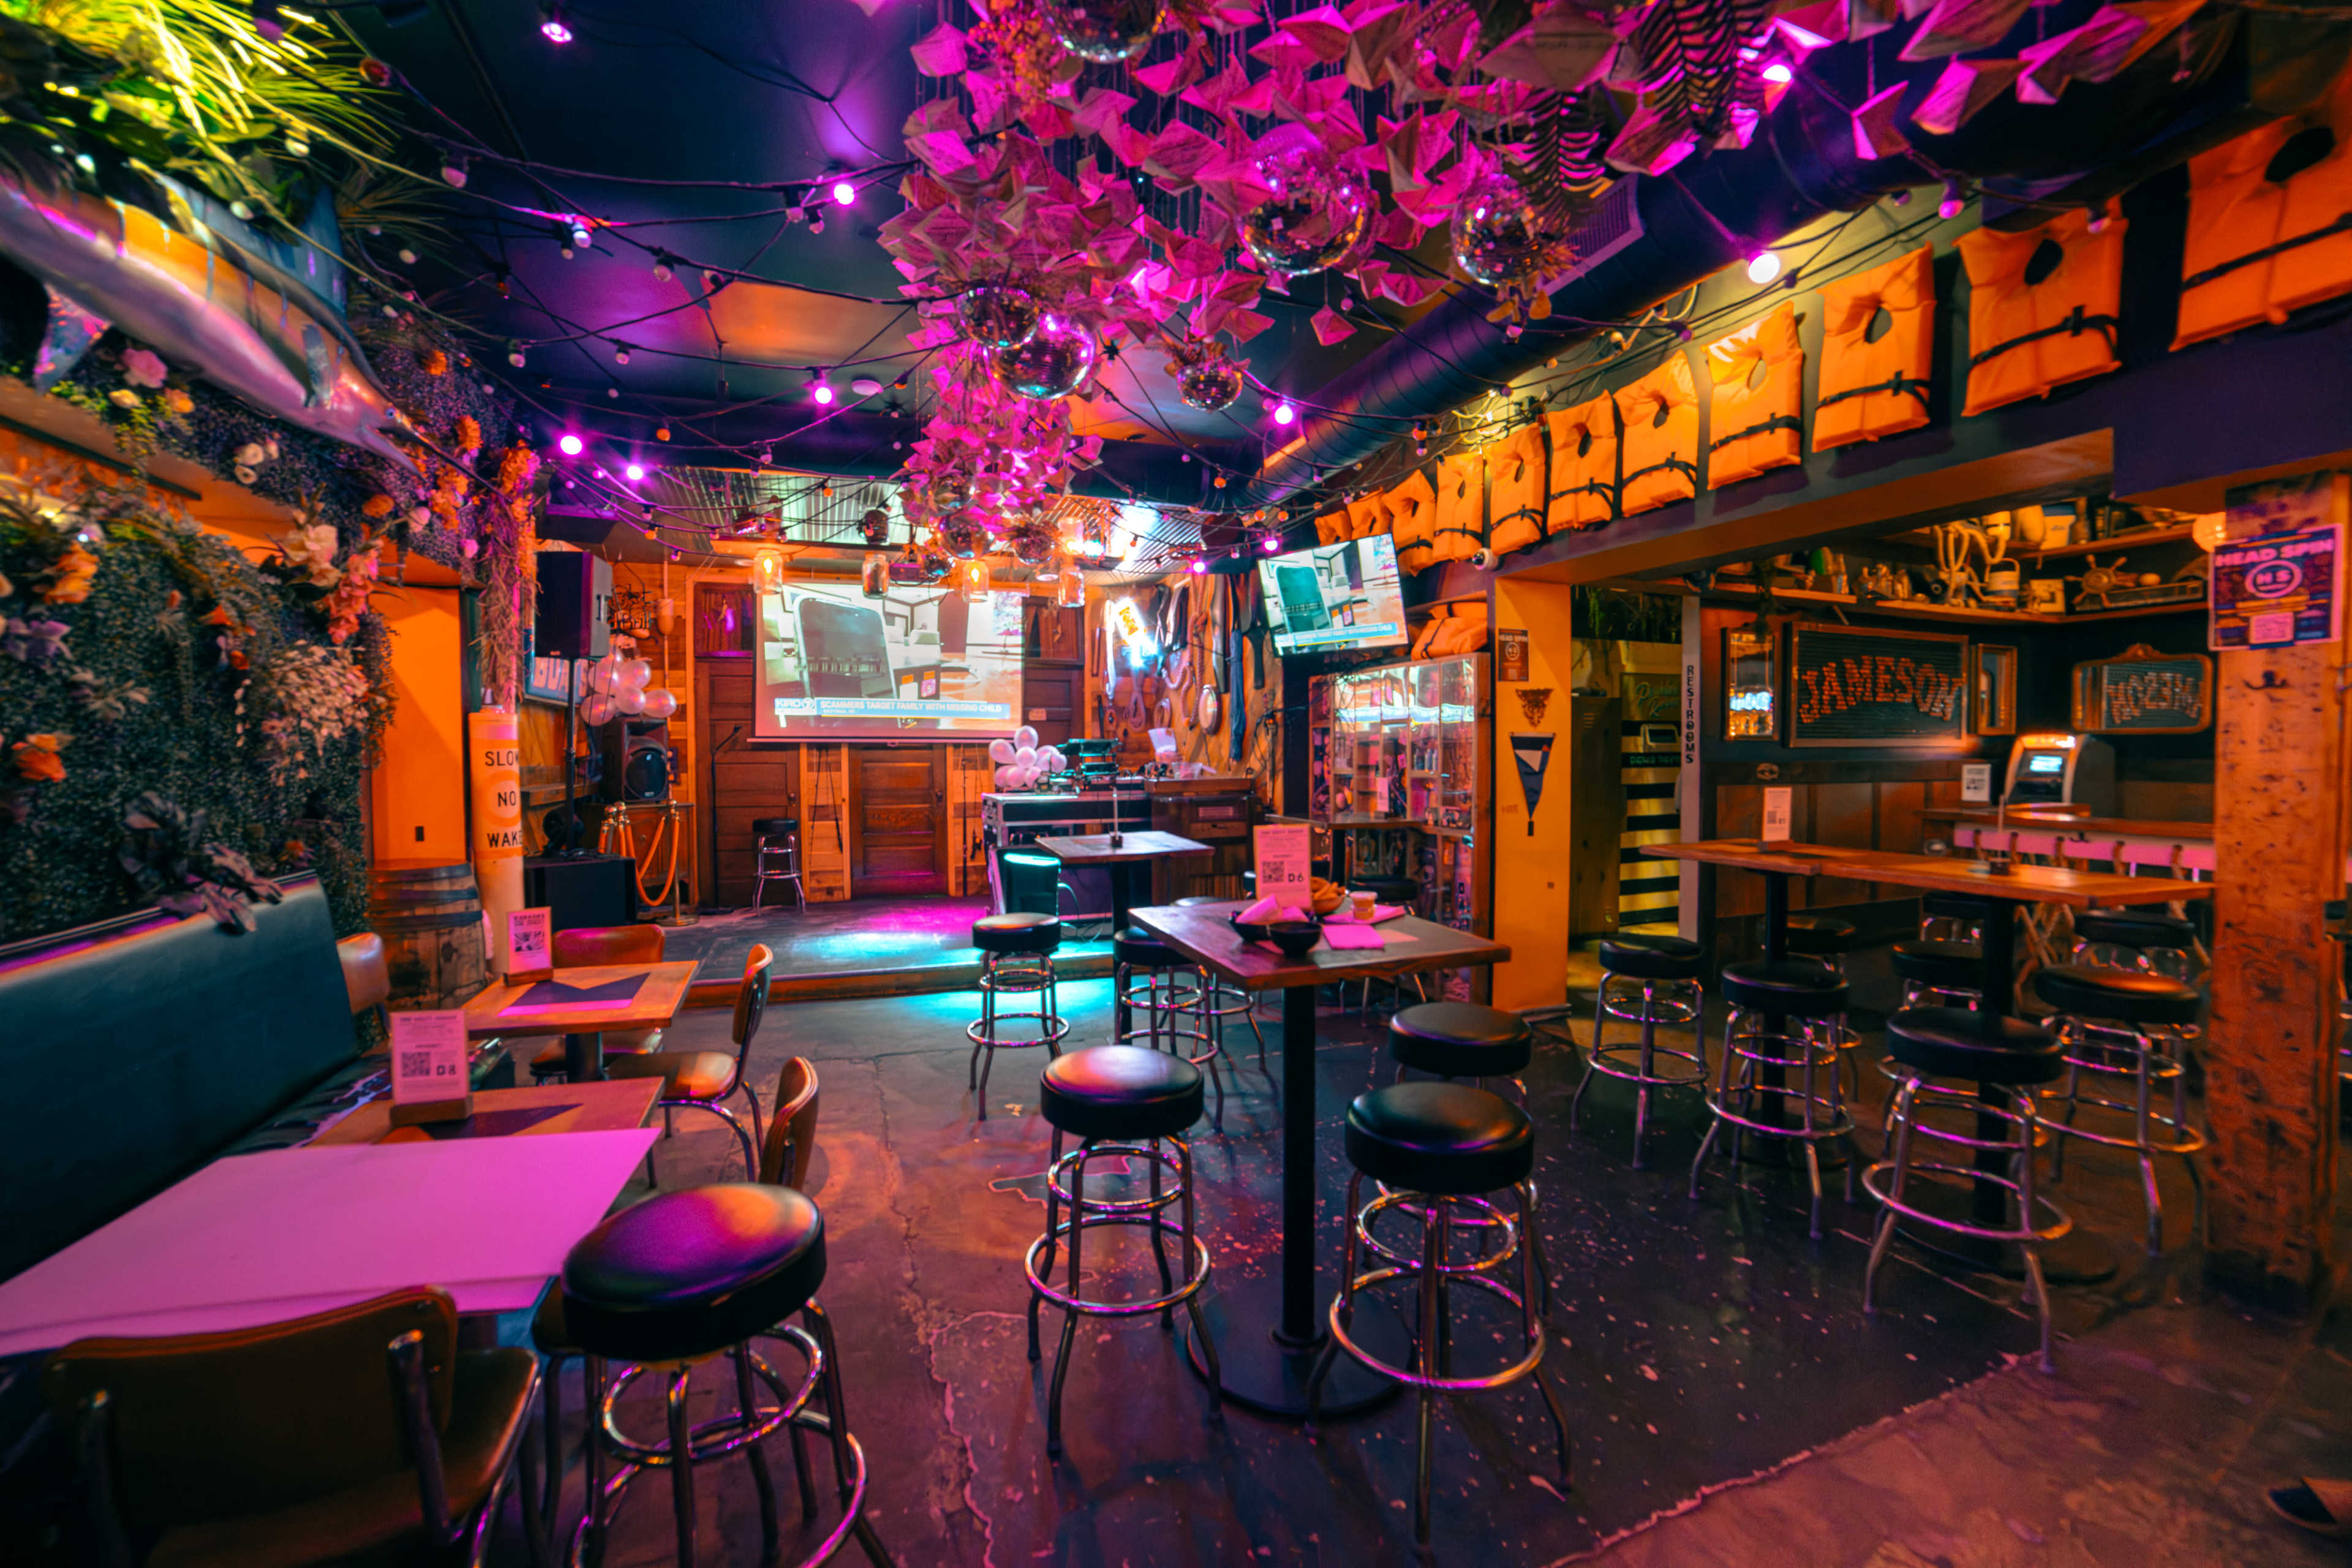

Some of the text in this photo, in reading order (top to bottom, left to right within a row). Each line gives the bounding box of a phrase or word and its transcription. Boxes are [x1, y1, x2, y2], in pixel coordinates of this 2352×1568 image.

[2215, 538, 2334, 567] HEAD SPIN
[1799, 655, 1964, 723] JAMESON
[820, 699, 864, 709] SCAMMERS
[867, 701, 894, 710] TARGET
[897, 701, 923, 710] FAMILY
[925, 702, 946, 711] WITH
[979, 703, 1002, 712] CHILD
[1686, 665, 1695, 764] RESTROOMS
[497, 790, 516, 807] NO
[487, 830, 522, 848] WAKE
